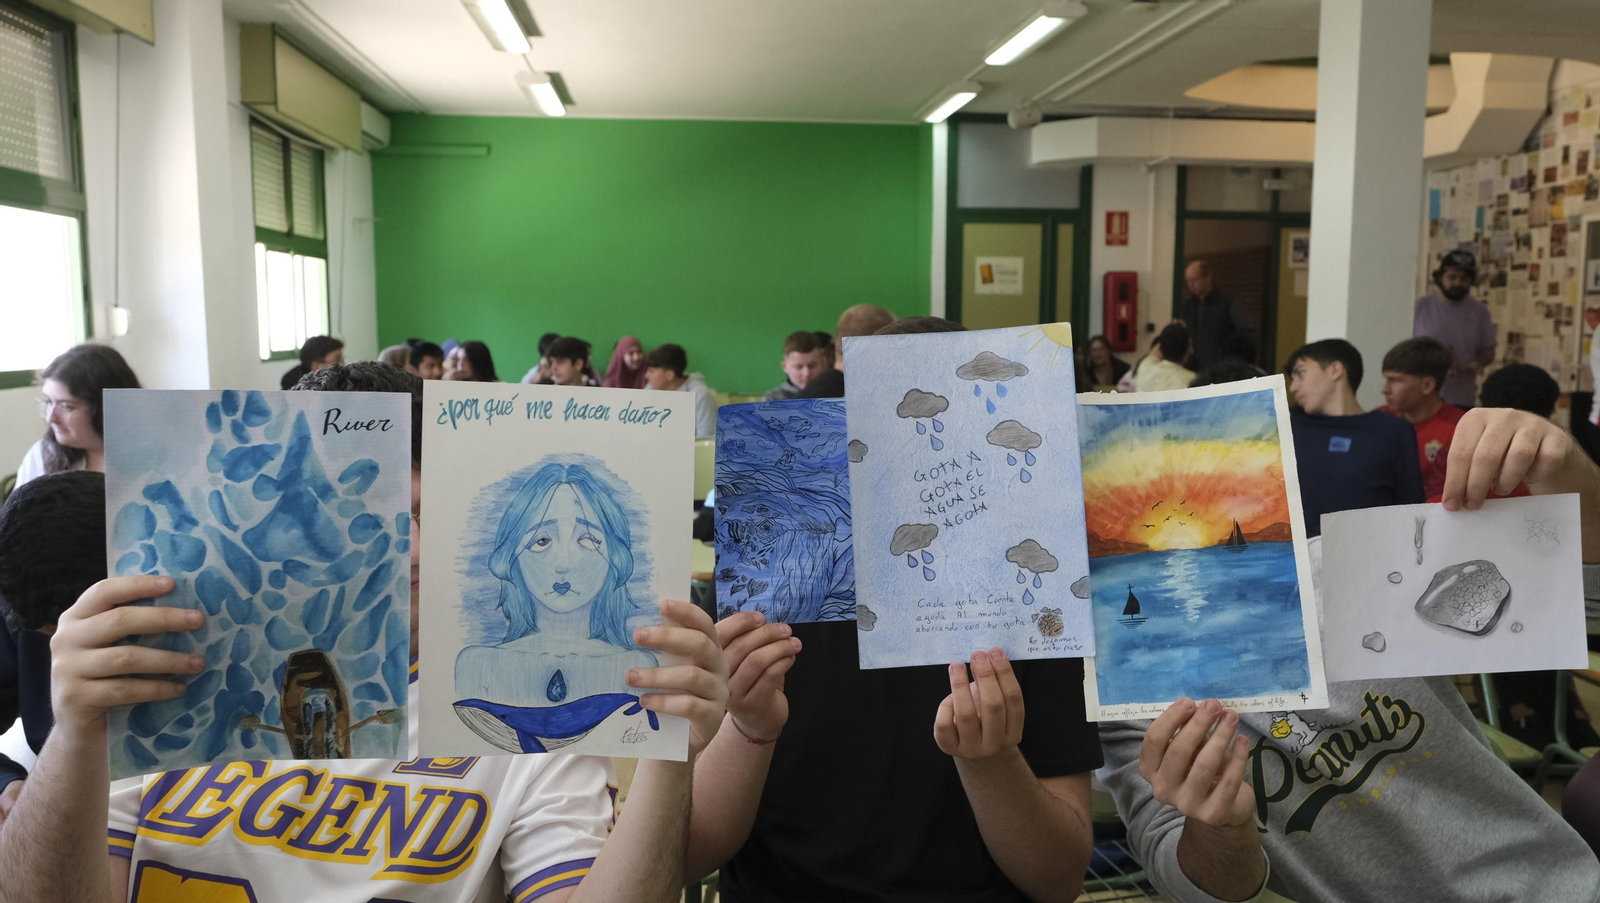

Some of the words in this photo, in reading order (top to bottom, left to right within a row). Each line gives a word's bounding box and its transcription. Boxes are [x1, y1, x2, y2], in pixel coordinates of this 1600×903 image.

[323, 407, 394, 435] River
[436, 397, 480, 430] ¿por
[484, 393, 520, 425] qué
[526, 400, 553, 421] me
[563, 397, 611, 423] hacen
[618, 401, 672, 429] daño?
[914, 458, 962, 482] GOTA
[967, 451, 981, 465] A
[920, 477, 962, 502] GOTA
[966, 468, 983, 481] EL
[924, 493, 964, 518] AGUA
[970, 485, 986, 499] SE
[943, 501, 988, 529] AGOTA
[917, 597, 946, 608] Cada
[955, 594, 978, 609] gota
[978, 607, 1007, 617] mundo
[1003, 616, 1025, 630] gota
[137, 759, 492, 884] LEGEND
